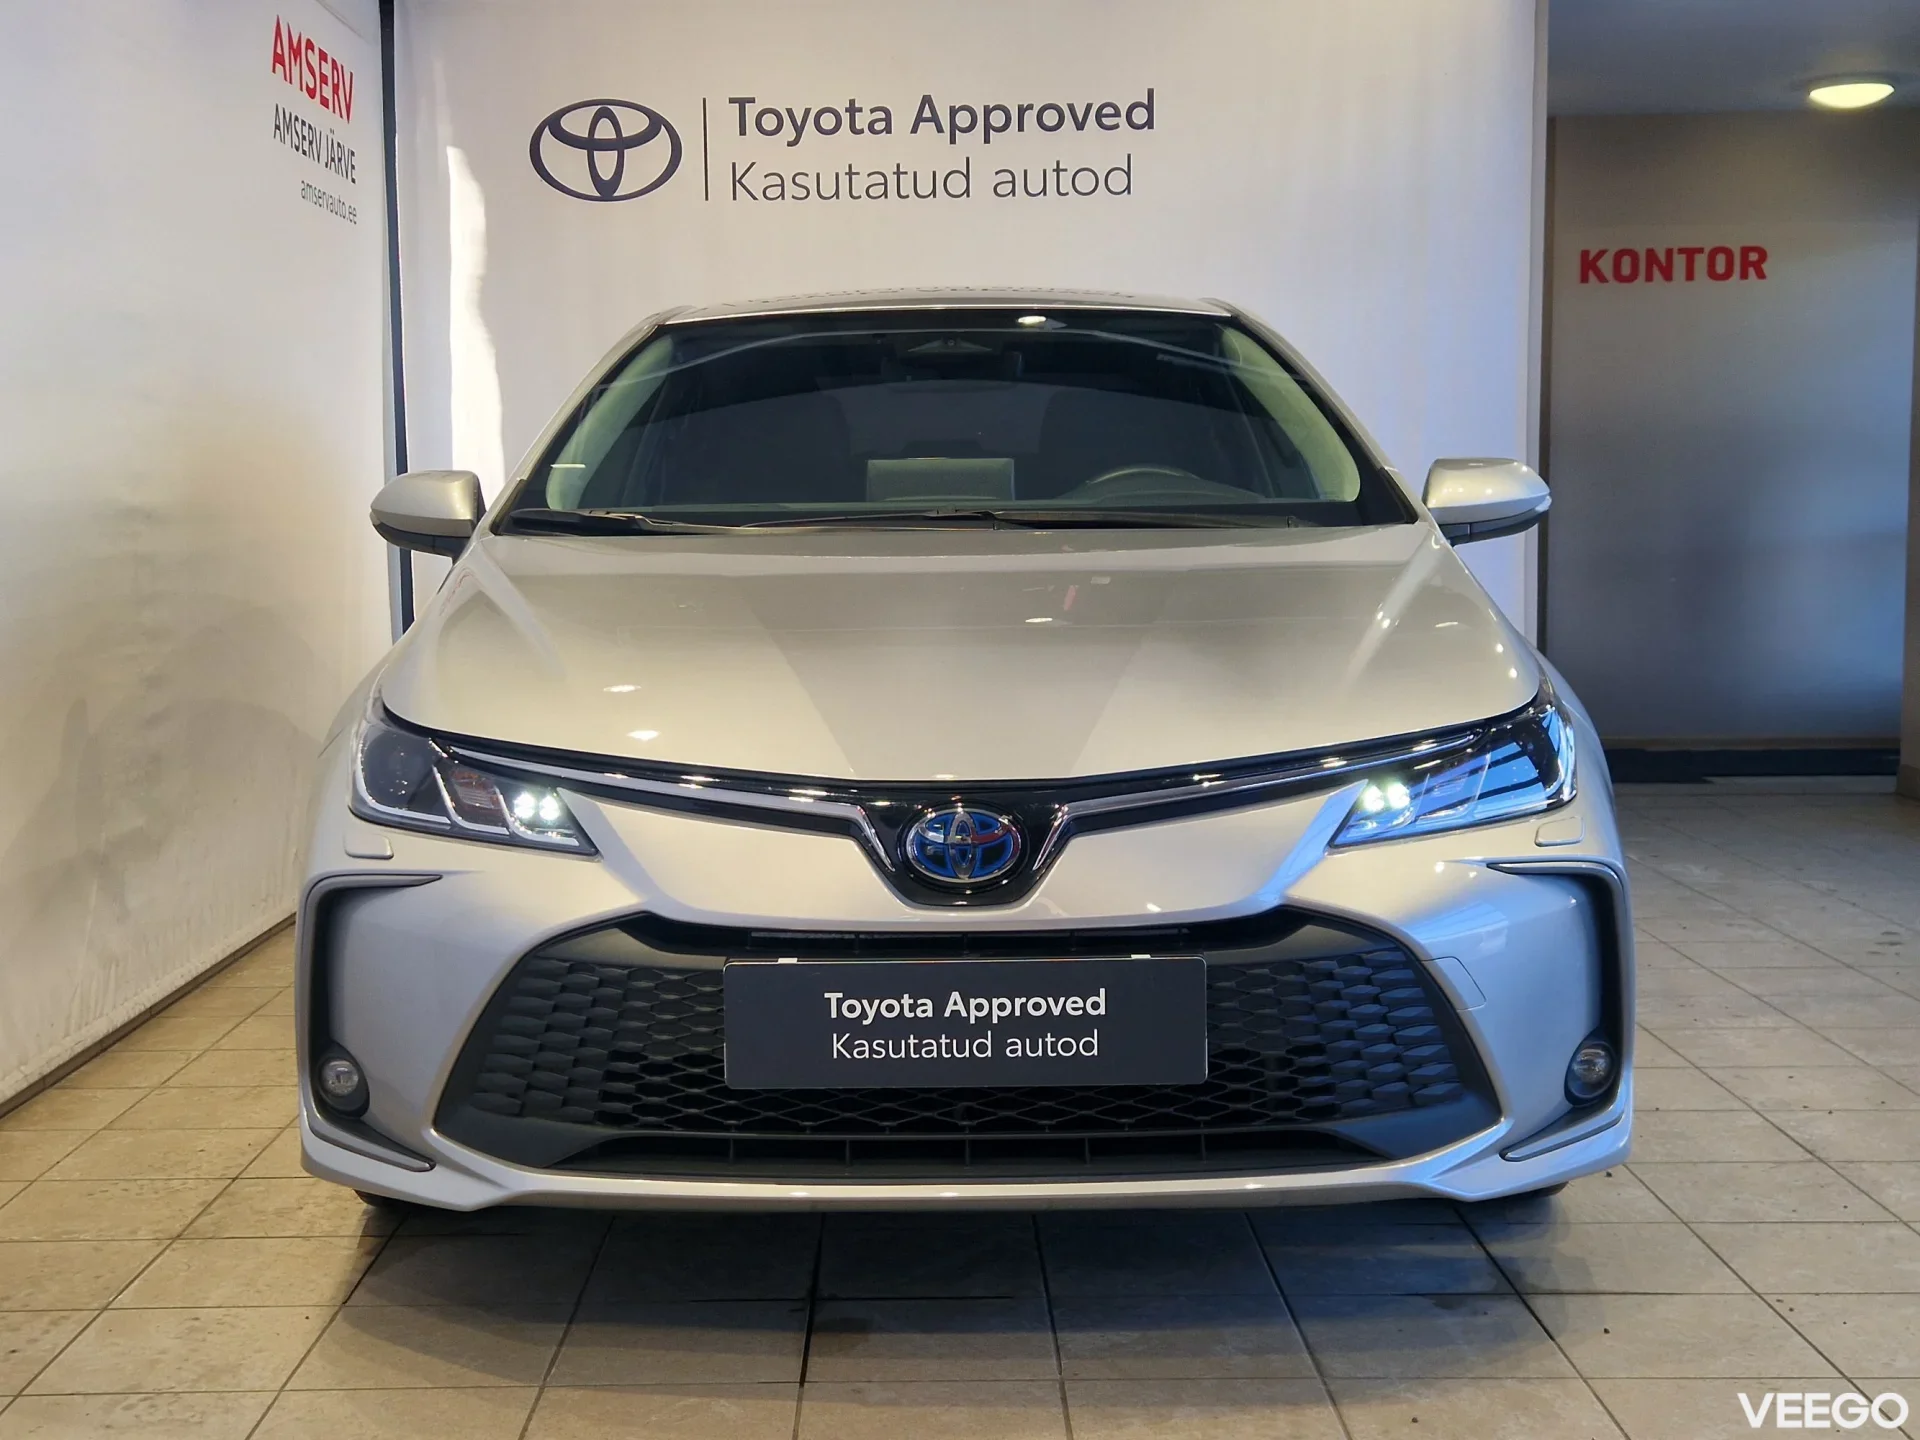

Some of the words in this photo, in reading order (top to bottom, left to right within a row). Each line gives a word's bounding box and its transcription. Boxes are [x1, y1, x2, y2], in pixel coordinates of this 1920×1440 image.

[272, 15, 354, 124] AMSERV
[728, 96, 893, 147] Toyota
[910, 88, 1156, 145] Approved
[273, 103, 322, 164] AMSERV
[324, 128, 356, 184] JÄRVE
[731, 157, 971, 201] Kasutatud
[992, 154, 1133, 197] autod
[300, 180, 357, 225] amservauto.ee
[1579, 245, 1769, 284] KONTOR
[824, 991, 934, 1025] Toyota
[944, 988, 1107, 1023] Approved
[832, 1031, 993, 1060] Kasutatud
[1005, 1029, 1099, 1058] autod
